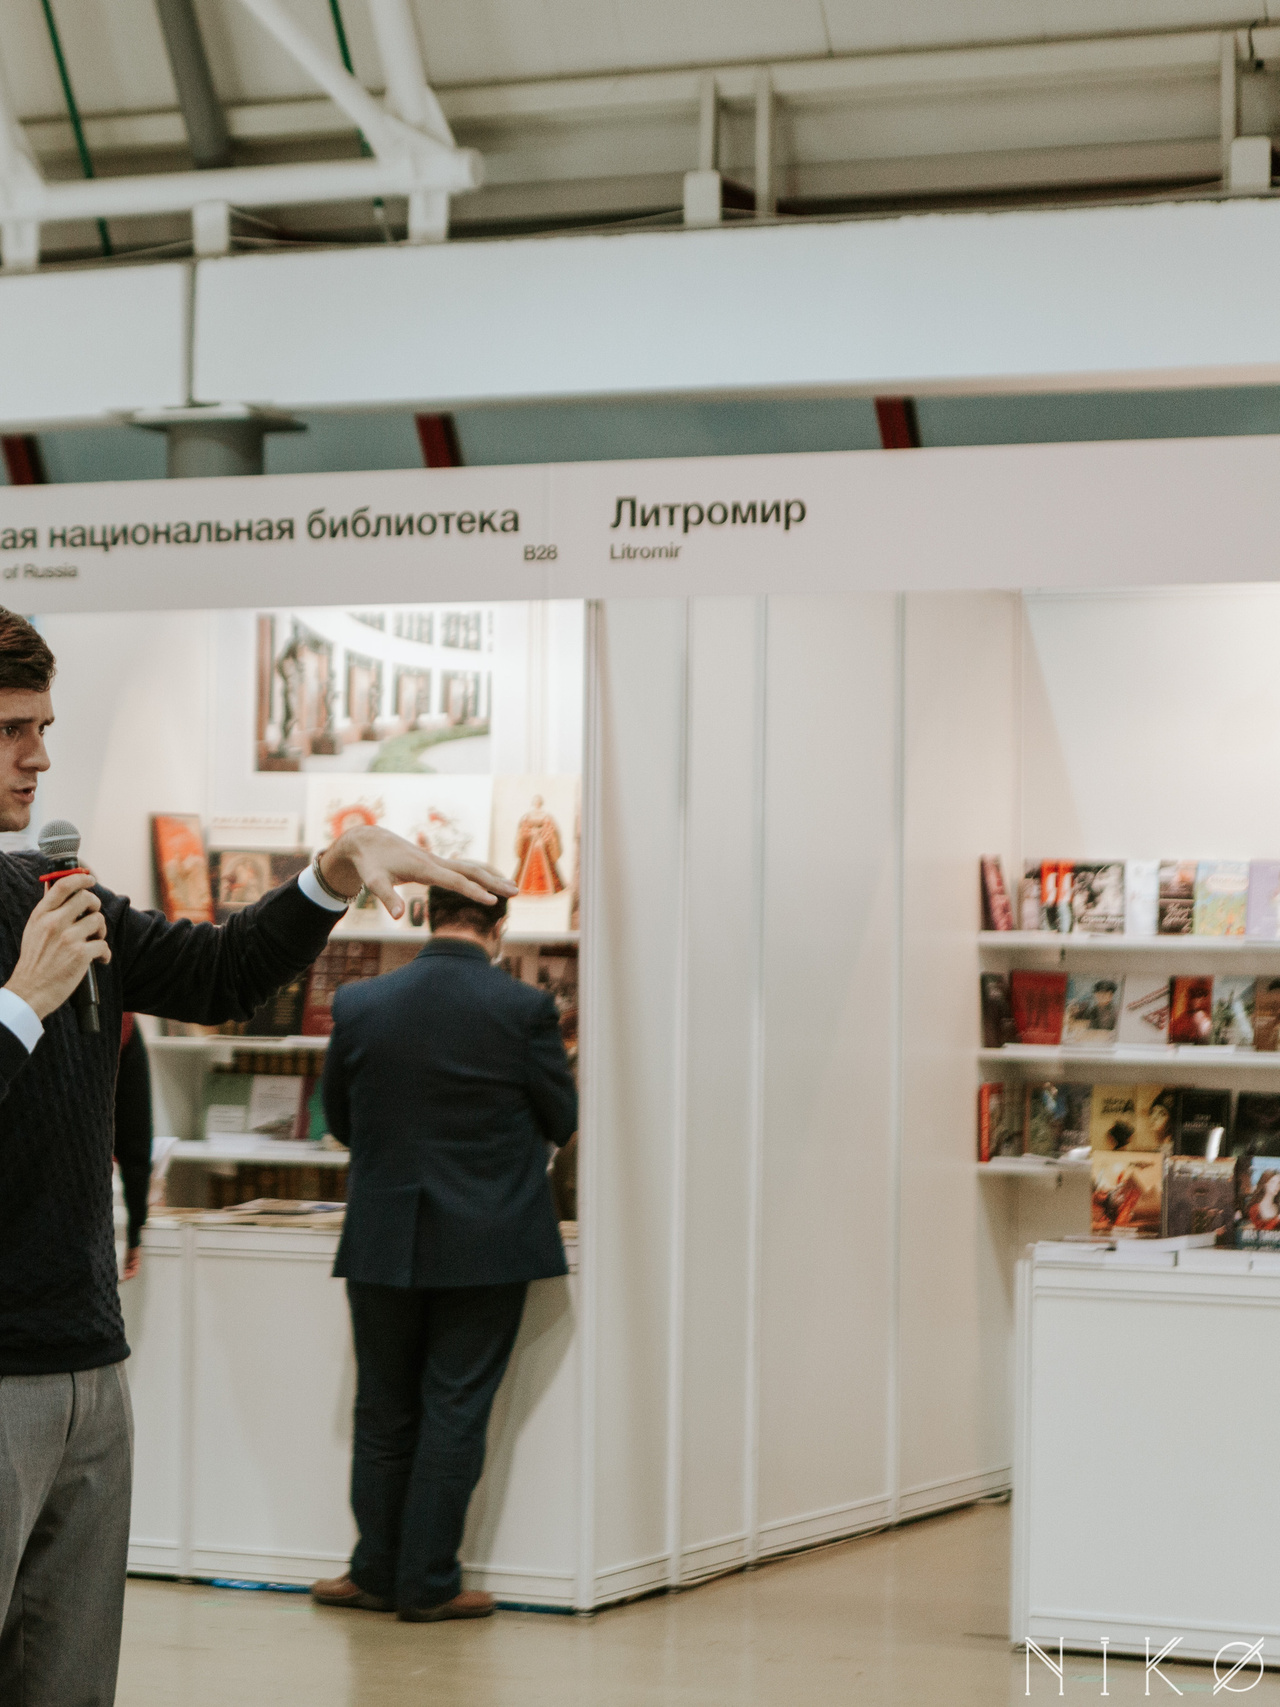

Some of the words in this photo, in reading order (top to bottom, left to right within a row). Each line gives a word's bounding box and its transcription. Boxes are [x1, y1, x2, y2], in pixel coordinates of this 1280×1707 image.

[610, 496, 807, 534] Литромир
[49, 517, 295, 552] национальная
[307, 504, 520, 540] библиотека
[523, 544, 558, 561] B28
[609, 542, 682, 560] Litromir
[2, 562, 20, 580] of
[23, 562, 78, 579] Russia
